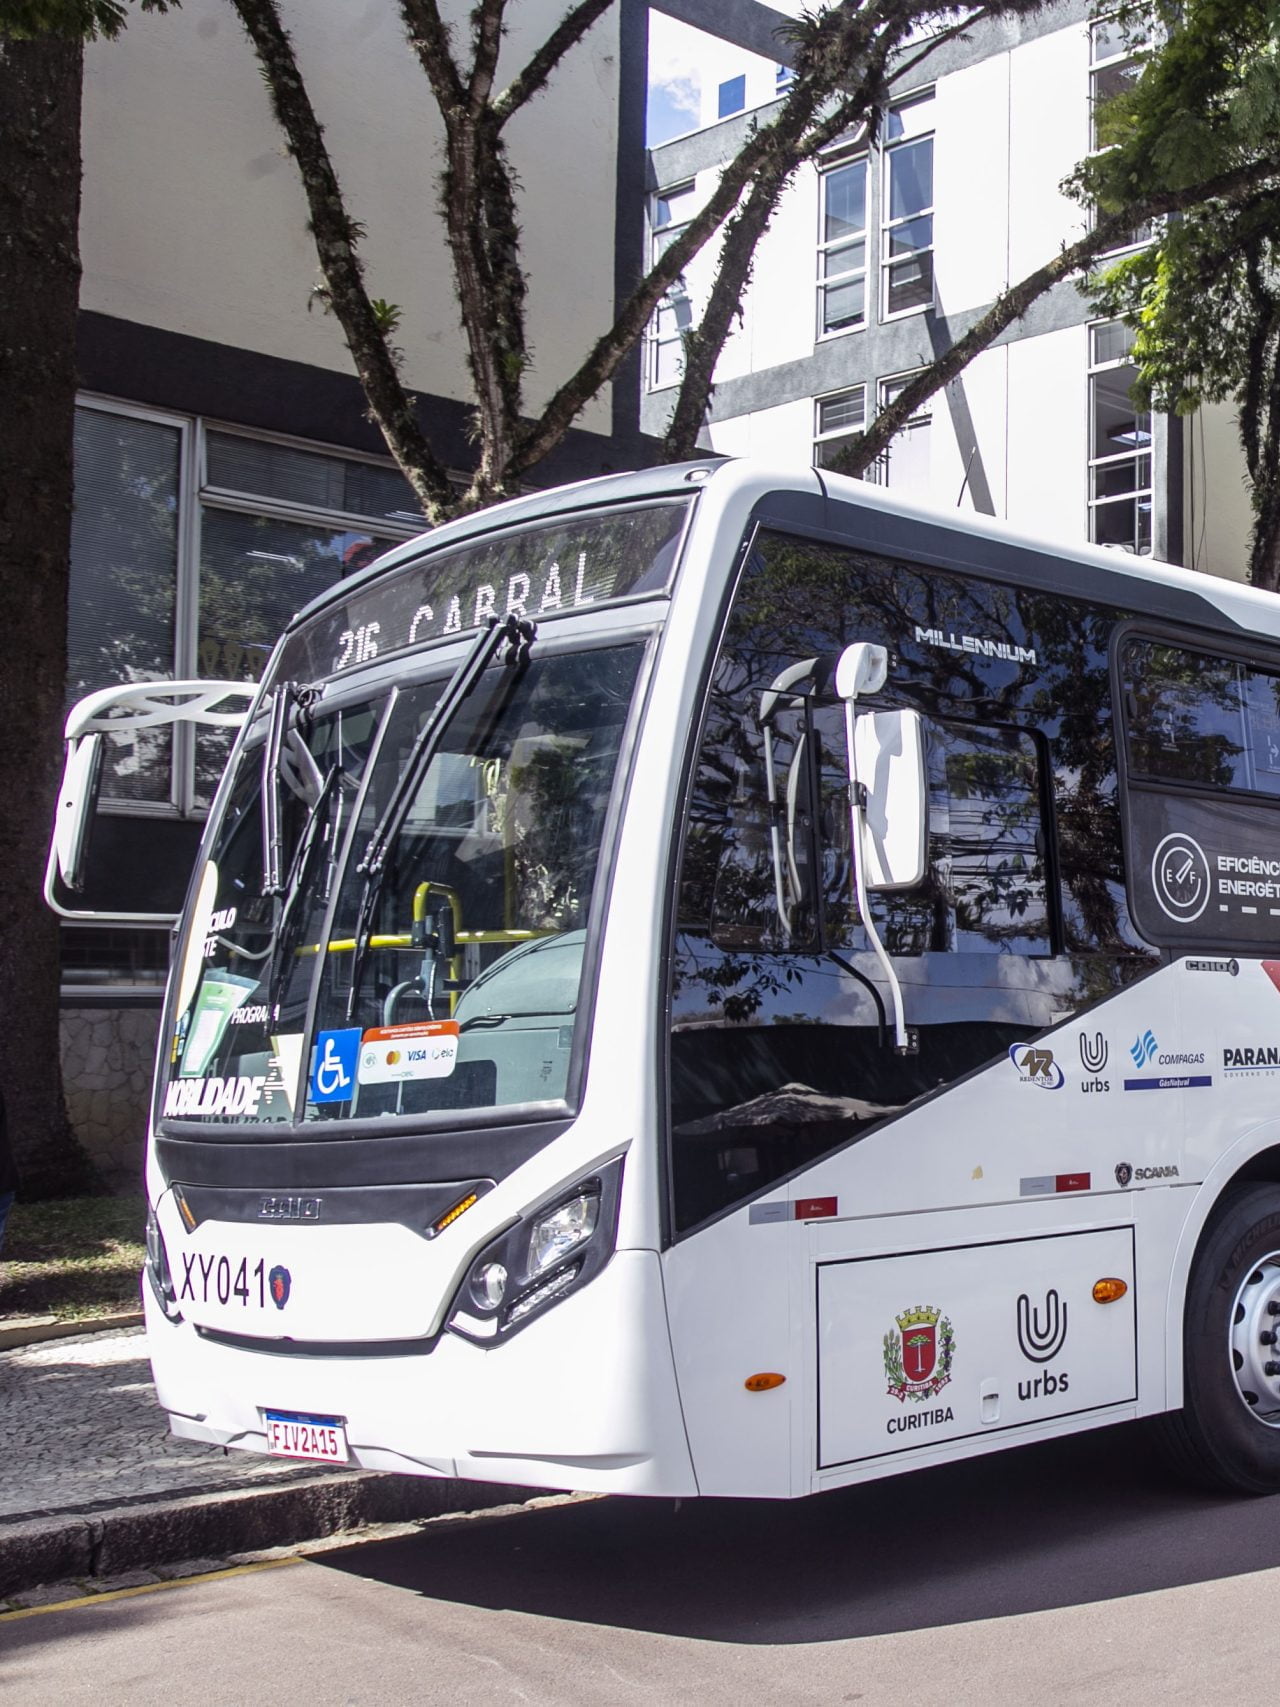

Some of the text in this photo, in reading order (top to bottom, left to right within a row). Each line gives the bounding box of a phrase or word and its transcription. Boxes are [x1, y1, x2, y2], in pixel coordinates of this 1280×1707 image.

[336, 621, 381, 669] 216
[915, 626, 1037, 664] MILLENNIUM
[1166, 869, 1196, 884] E F
[231, 1004, 281, 1024] PROGRAA
[407, 1050, 426, 1061] VISA
[1158, 1053, 1205, 1065] COMPAGAS
[163, 1076, 265, 1117] MOBILIDADE
[1081, 1077, 1110, 1093] urbs
[1135, 1165, 1179, 1180] SCANIA
[180, 1252, 265, 1308] XY041
[1018, 1369, 1069, 1401] urbs
[886, 1407, 954, 1434] CURITIBA
[273, 1424, 337, 1455] FIV2A15
